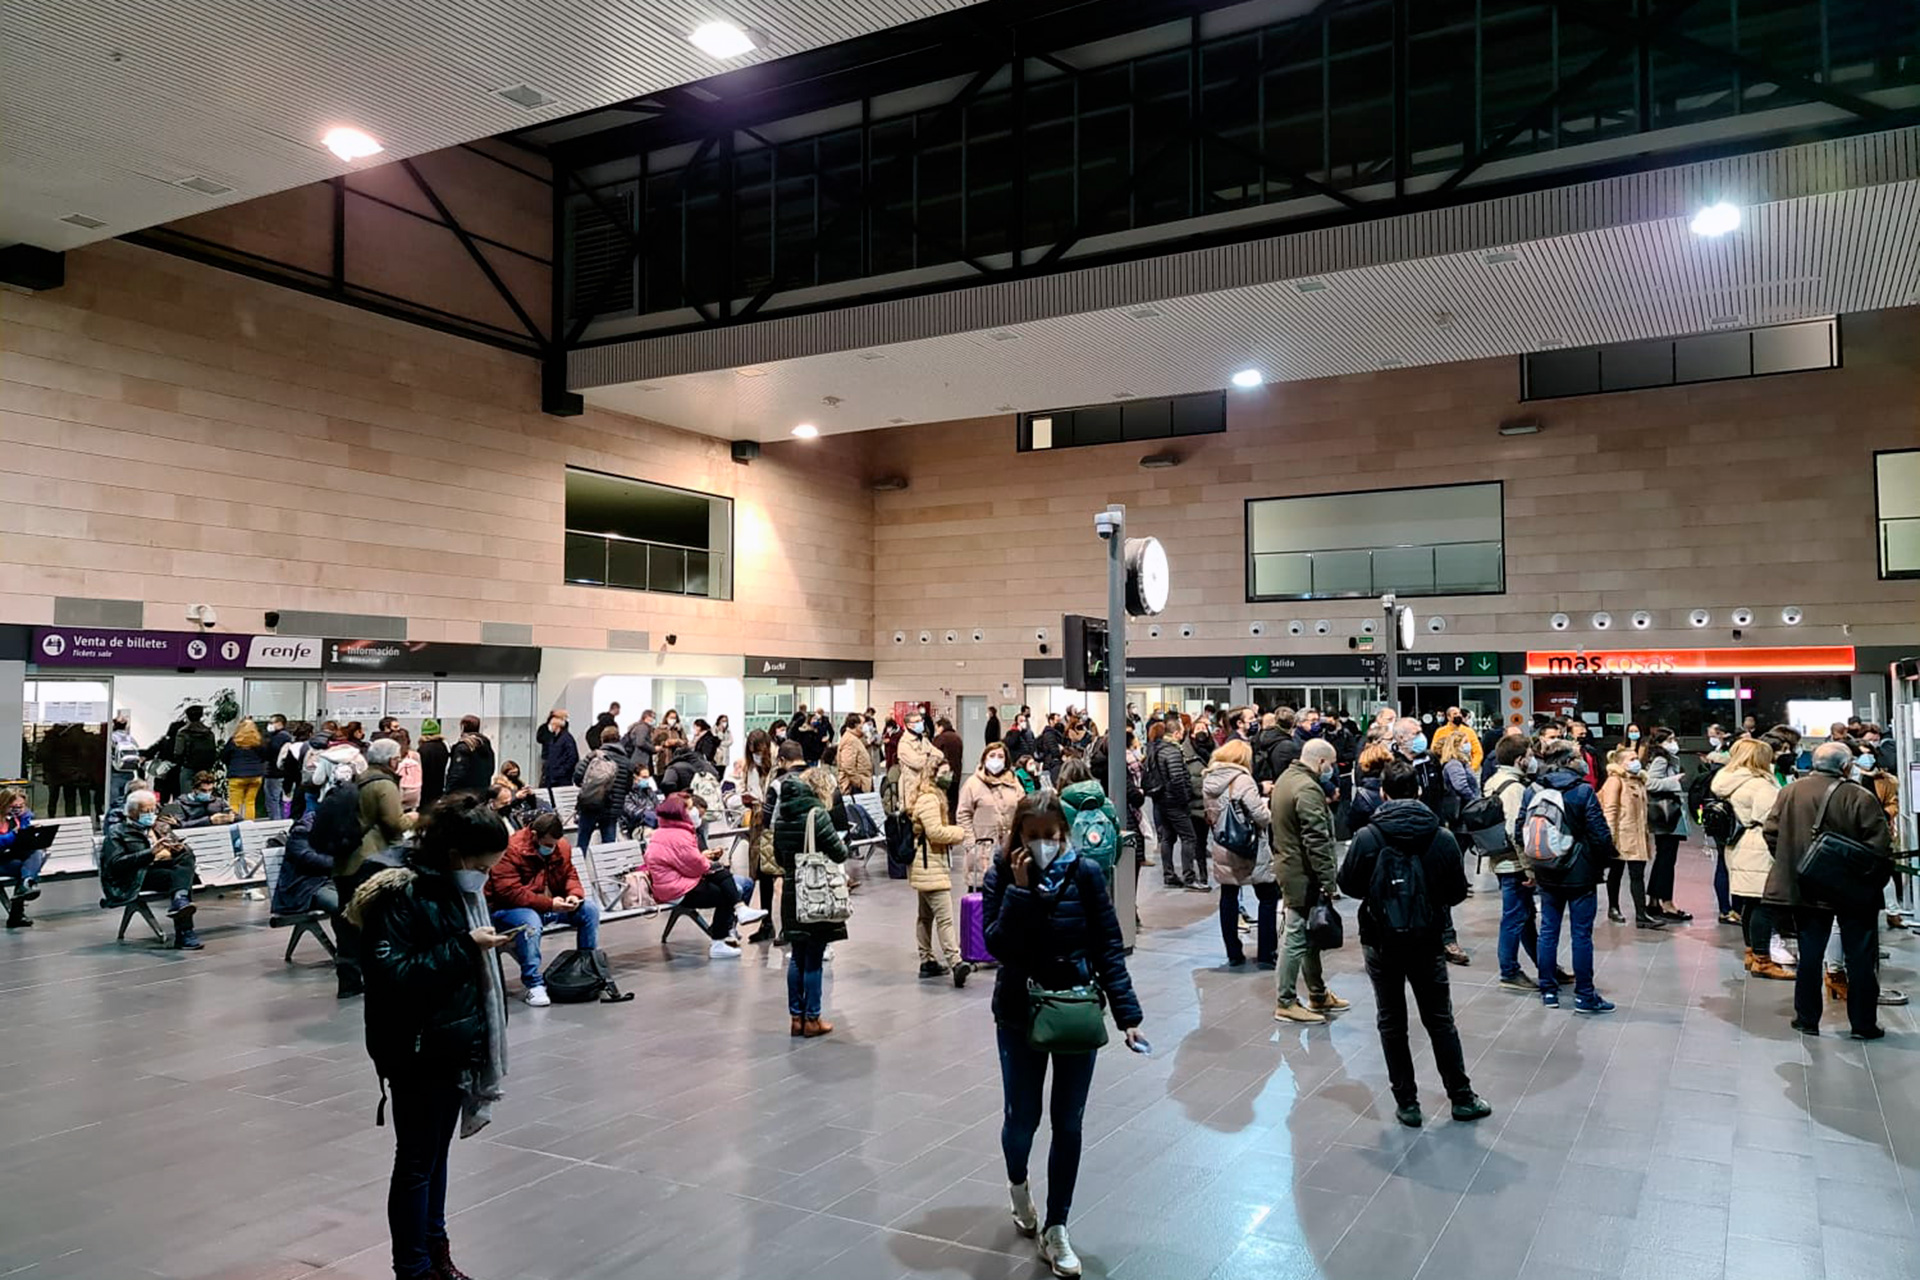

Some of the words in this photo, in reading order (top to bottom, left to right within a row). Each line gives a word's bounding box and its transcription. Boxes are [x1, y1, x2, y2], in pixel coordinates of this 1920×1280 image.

[73, 635, 106, 647] Venta
[109, 637, 124, 647] de
[126, 637, 168, 649] billetes
[72, 649, 96, 657] Tickets
[261, 642, 311, 661] renfe
[1270, 659, 1295, 667] Salida
[1406, 658, 1422, 666] Bus
[1454, 657, 1465, 671] P
